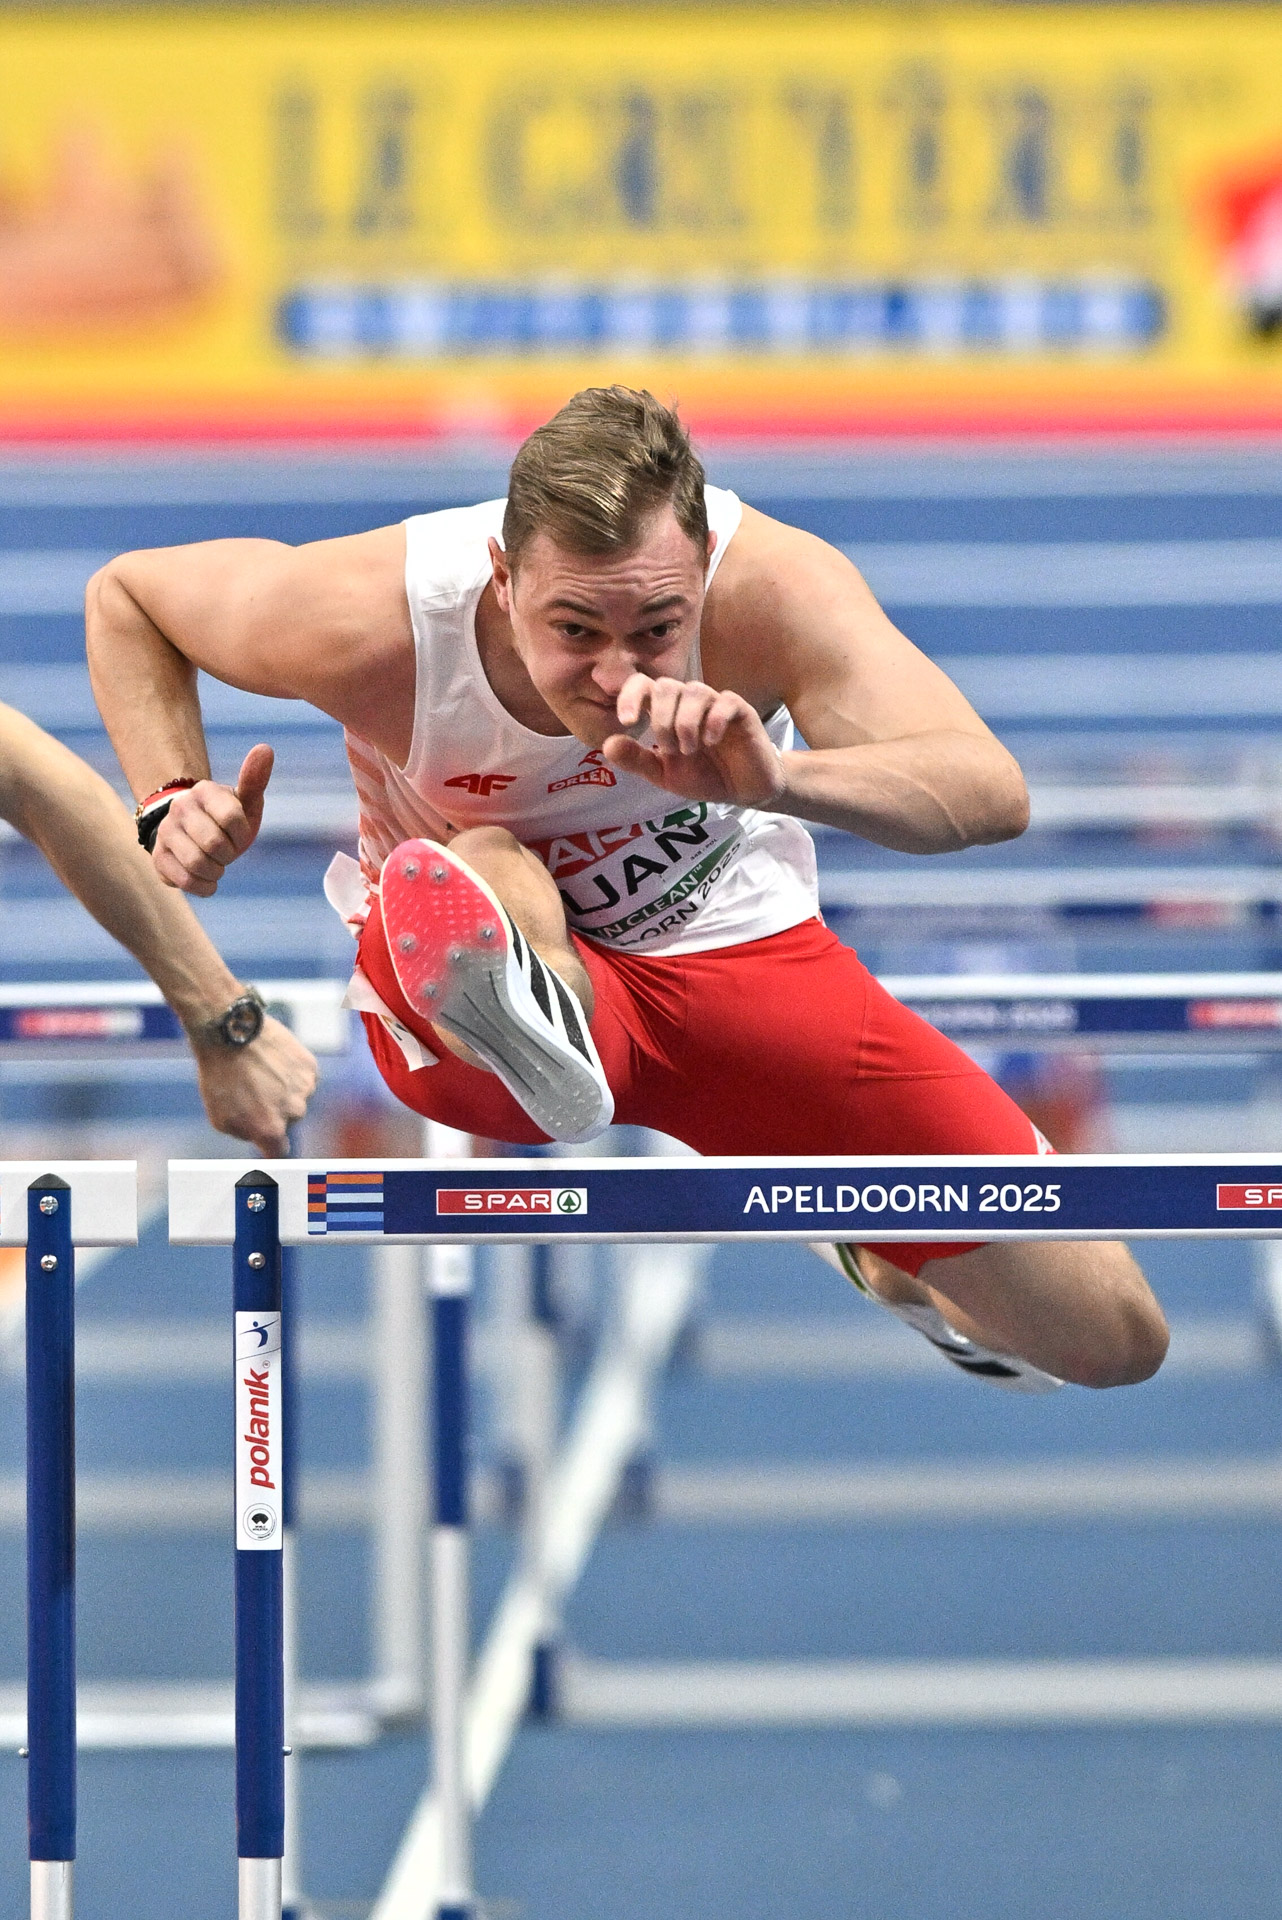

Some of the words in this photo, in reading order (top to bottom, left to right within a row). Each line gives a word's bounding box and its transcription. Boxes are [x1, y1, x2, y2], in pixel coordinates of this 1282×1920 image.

[444, 773, 518, 797] 4F
[551, 767, 613, 791] ORLEN
[464, 1193, 550, 1210] SPAR
[743, 1184, 968, 1214] APELDOORN
[979, 1184, 1062, 1212] 2025
[243, 1367, 276, 1490] polanik
